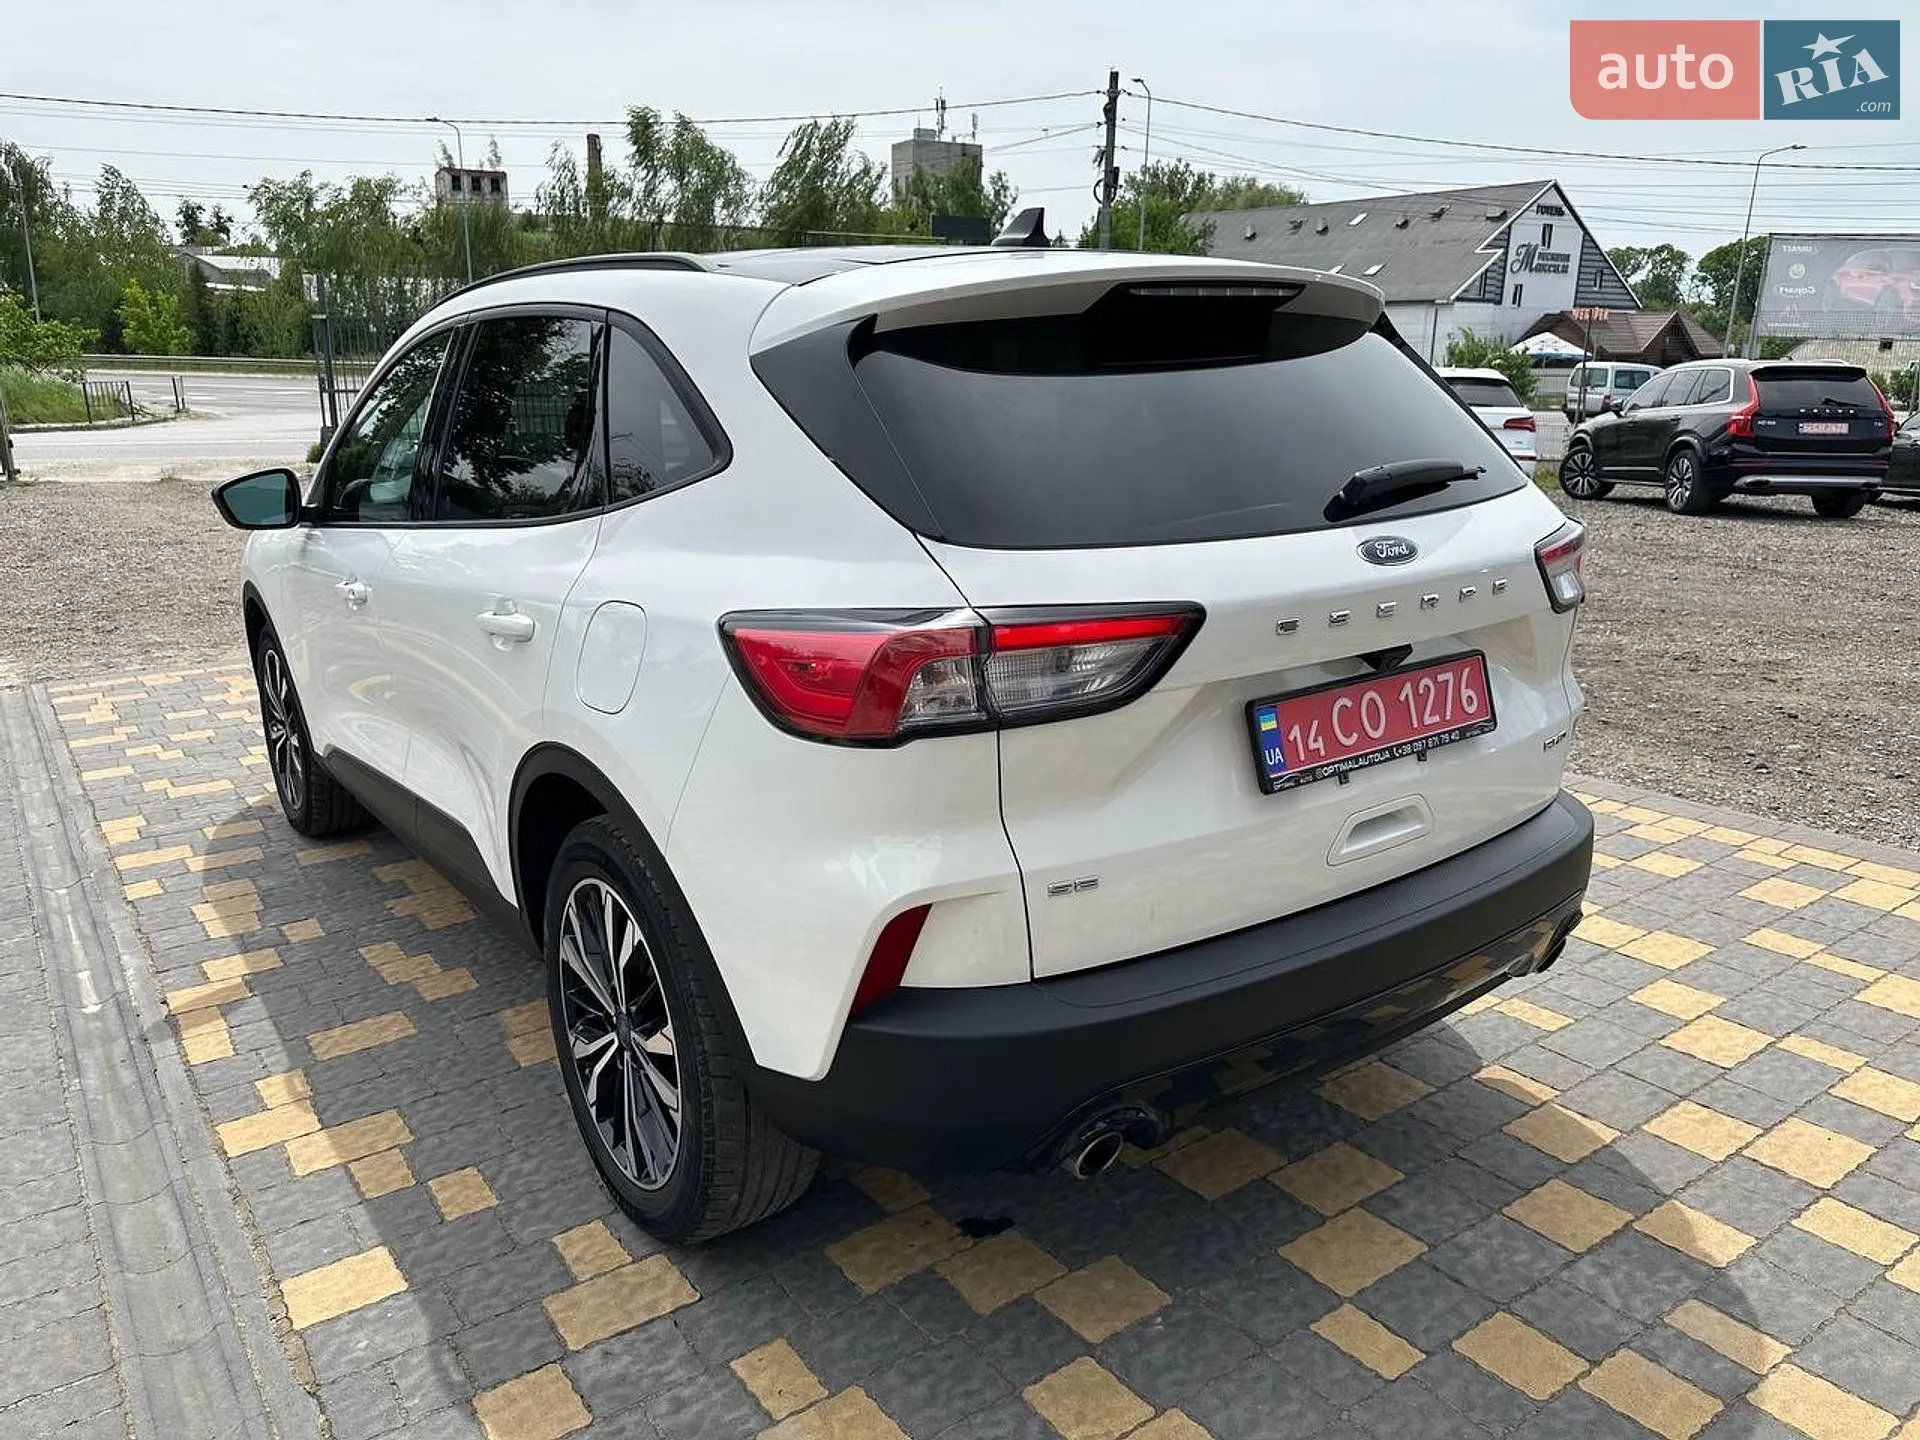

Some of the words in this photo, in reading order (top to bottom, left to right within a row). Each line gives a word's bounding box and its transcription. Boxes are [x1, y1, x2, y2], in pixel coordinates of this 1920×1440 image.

[1375, 540, 1410, 558] Ford
[1288, 720, 1326, 761] 14
[1332, 690, 1386, 747] CO
[1398, 667, 1478, 729] 1276
[1265, 747, 1284, 765] UA
